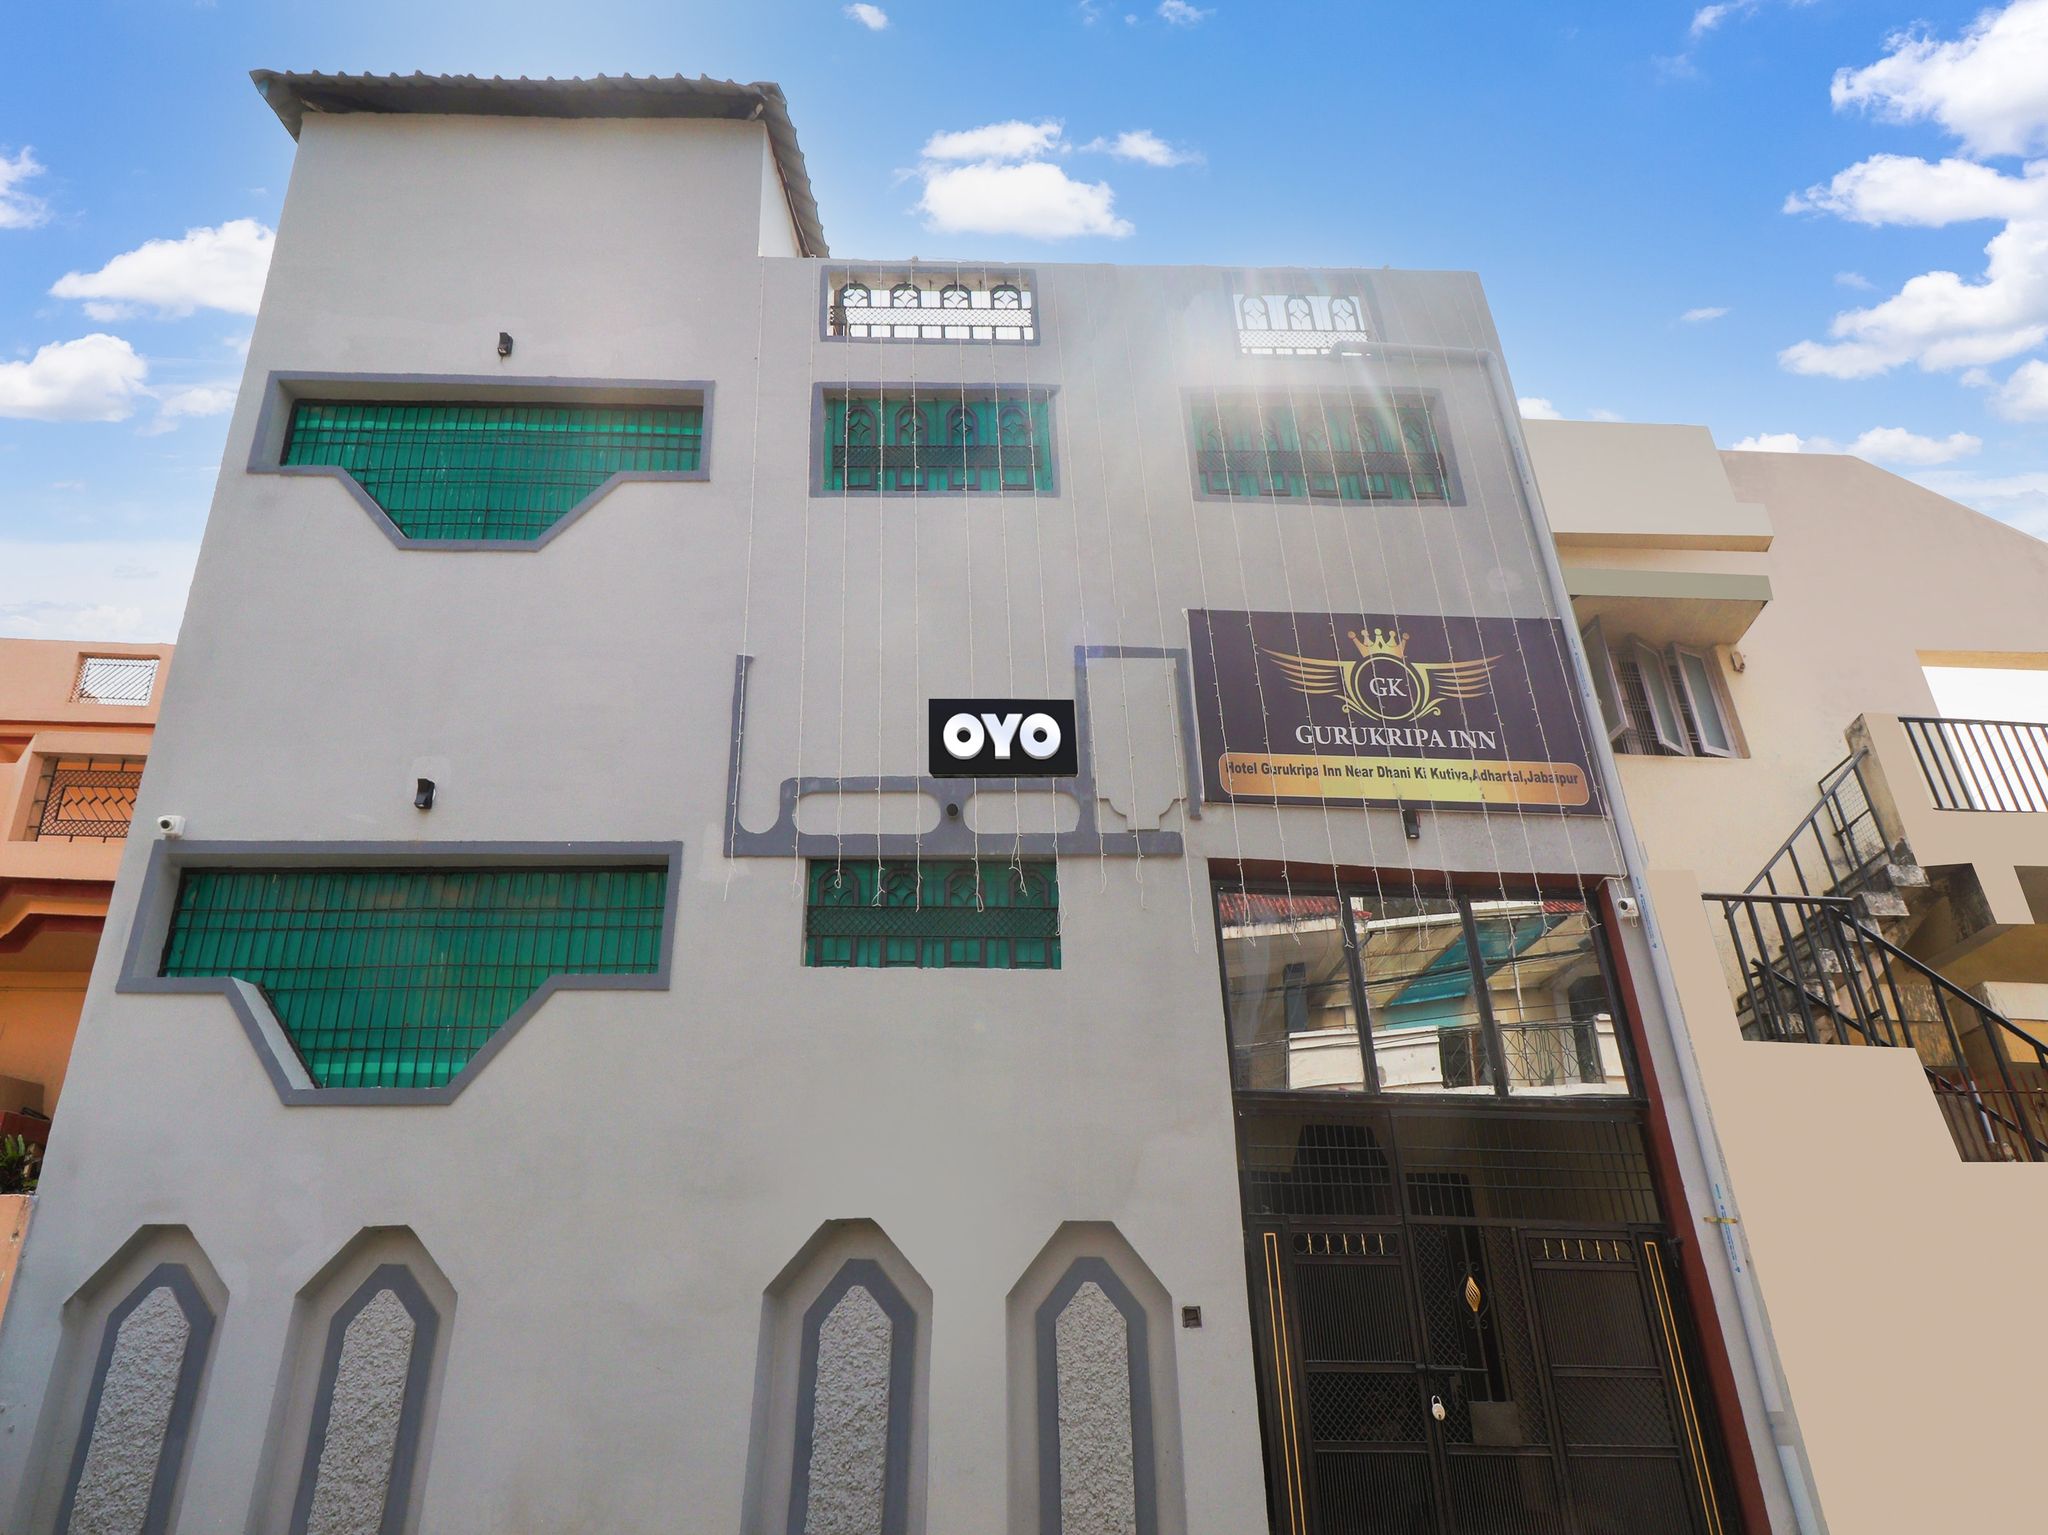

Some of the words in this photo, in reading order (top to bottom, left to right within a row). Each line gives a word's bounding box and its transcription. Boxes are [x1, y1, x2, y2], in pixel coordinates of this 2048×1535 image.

[1369, 677, 1407, 697] GK
[943, 712, 1062, 760] OYO
[1295, 725, 1446, 748] GURUKRIPA
[1447, 729, 1496, 750] INN
[1226, 761, 1258, 775] Hotel
[1261, 762, 1319, 779] Gurukripa
[1323, 764, 1342, 777] Inn
[1345, 764, 1374, 778] Near
[1377, 765, 1411, 779] Dhani
[1414, 766, 1427, 780] Ki
